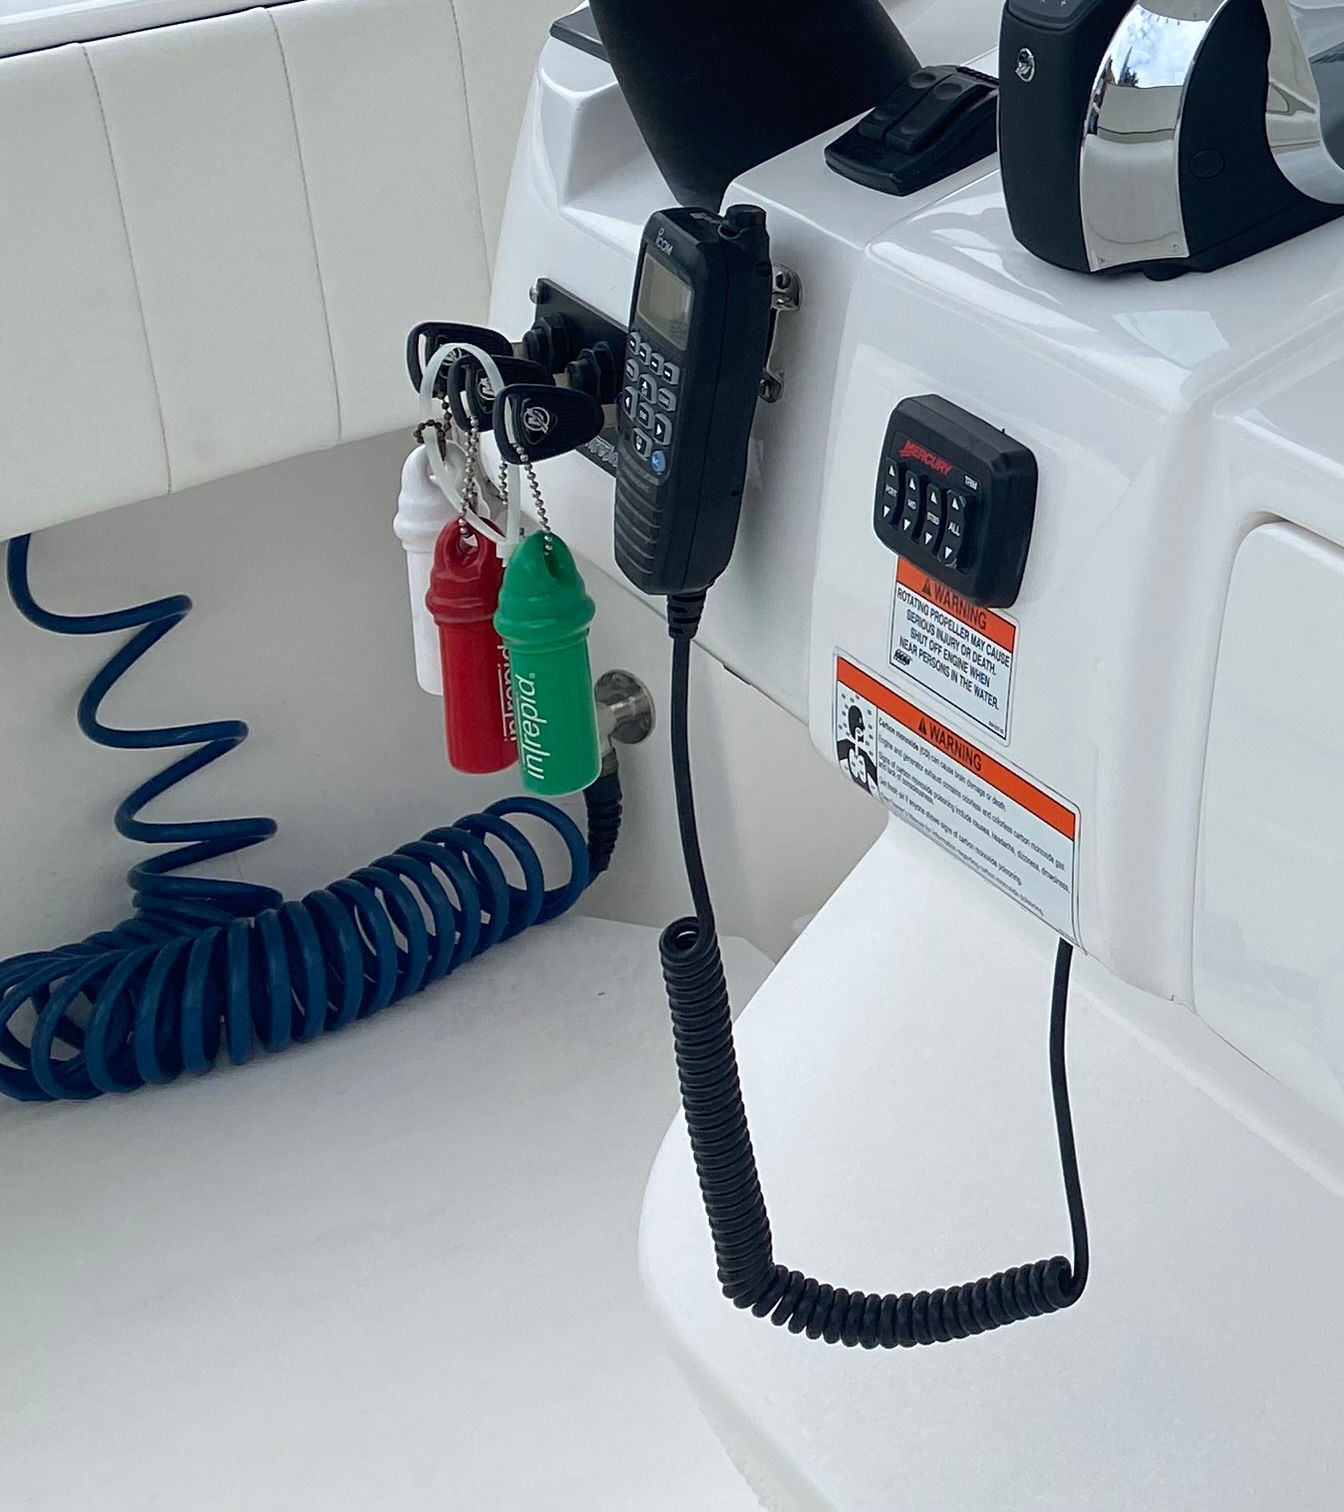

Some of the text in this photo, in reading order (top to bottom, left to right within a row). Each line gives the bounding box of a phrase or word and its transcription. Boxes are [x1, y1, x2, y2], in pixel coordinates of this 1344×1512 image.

[899, 439, 953, 477] MERCURY
[947, 521, 960, 537] ALL
[897, 588, 1010, 667] ROTATING PROPELLER MAY CAUSE
[934, 583, 987, 631] WARNING
[906, 610, 996, 675] SERIOUS INJURY OR DEATH.
[910, 628, 990, 687] SHUT OFF ENGINE WHEN
[899, 636, 917, 655] NEAR
[918, 649, 949, 677] PERSONS
[951, 670, 957, 682] IN
[959, 676, 972, 692] THE
[973, 685, 999, 710] WATER.
[929, 719, 982, 772] WARNING
